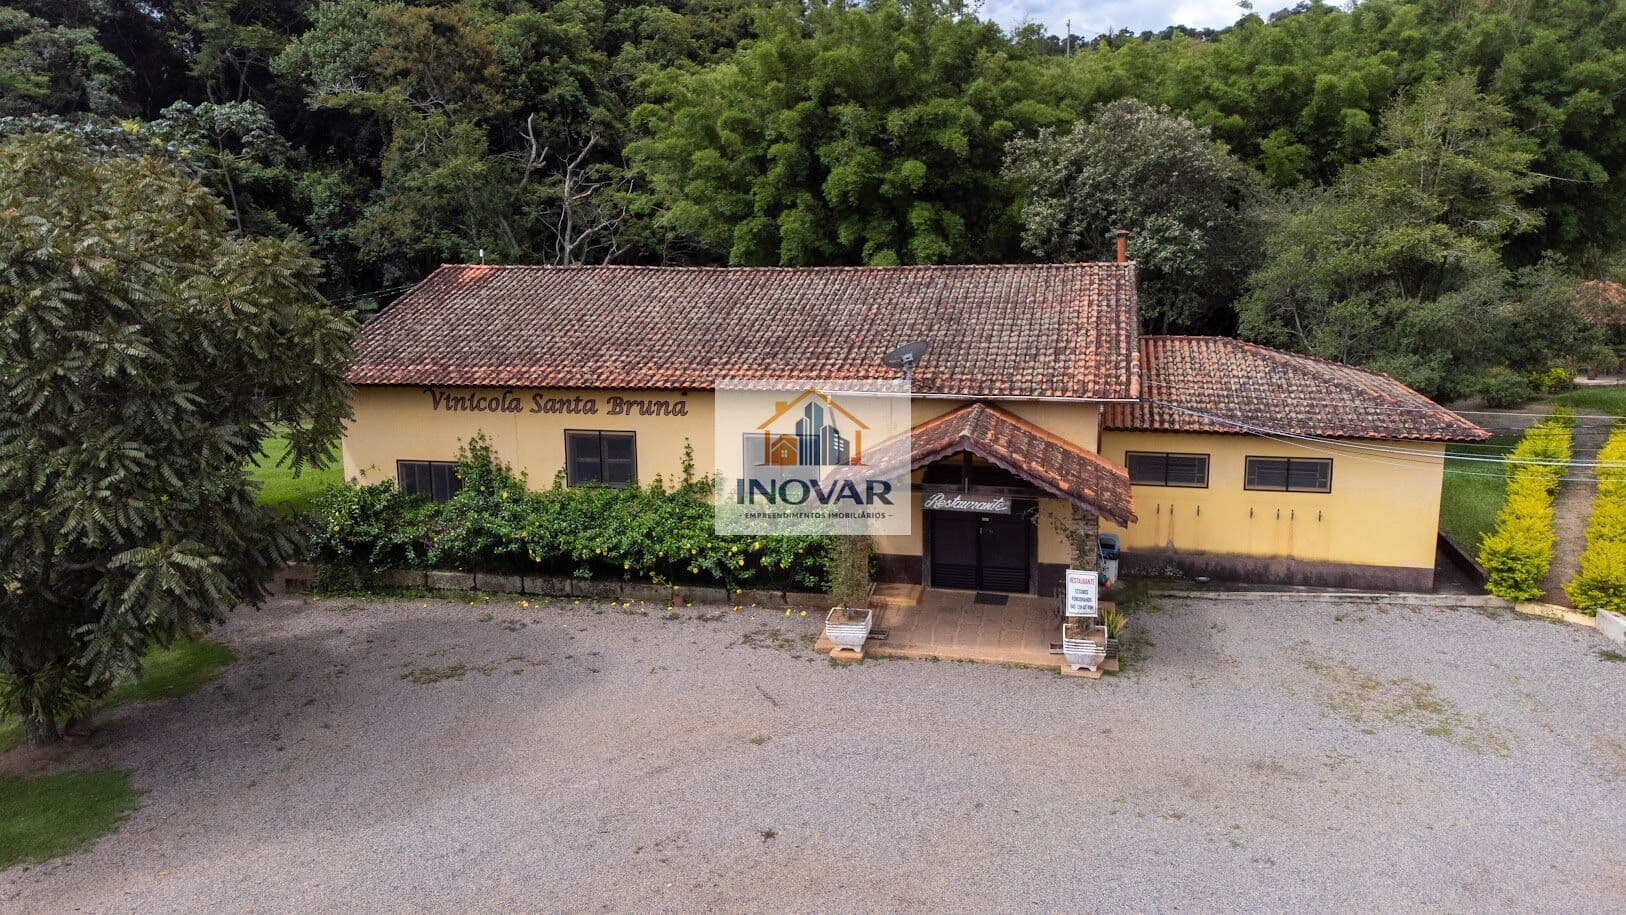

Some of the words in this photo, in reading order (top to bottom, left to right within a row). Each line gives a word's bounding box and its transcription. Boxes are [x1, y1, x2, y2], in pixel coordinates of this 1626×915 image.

[530, 393, 598, 414] Santa
[606, 396, 689, 417] Bruna
[924, 492, 1008, 511] Restaurante
